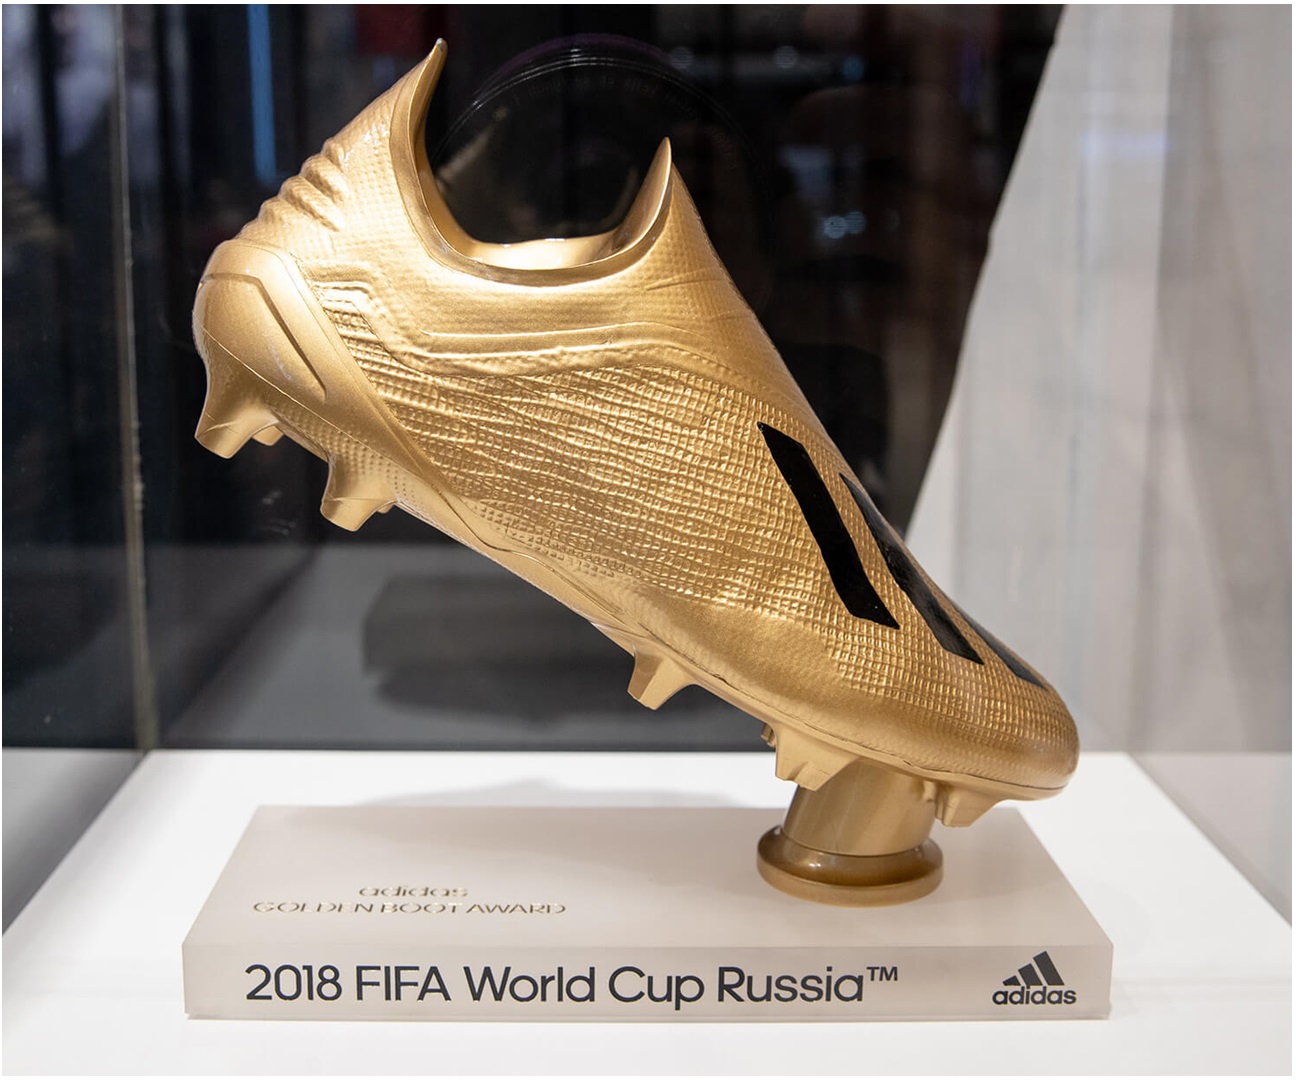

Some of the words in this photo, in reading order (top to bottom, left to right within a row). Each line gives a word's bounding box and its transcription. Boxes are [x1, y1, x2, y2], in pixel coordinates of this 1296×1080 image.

[358, 886, 469, 897] adidas
[253, 902, 374, 913] GOLDEN
[380, 902, 463, 913] BOOT
[466, 903, 566, 913] AWARD
[245, 964, 343, 1001] 2018
[355, 965, 452, 1002] FIFA
[462, 966, 596, 1003] World
[608, 965, 705, 1012] Cup
[991, 984, 1077, 1006] adidas
